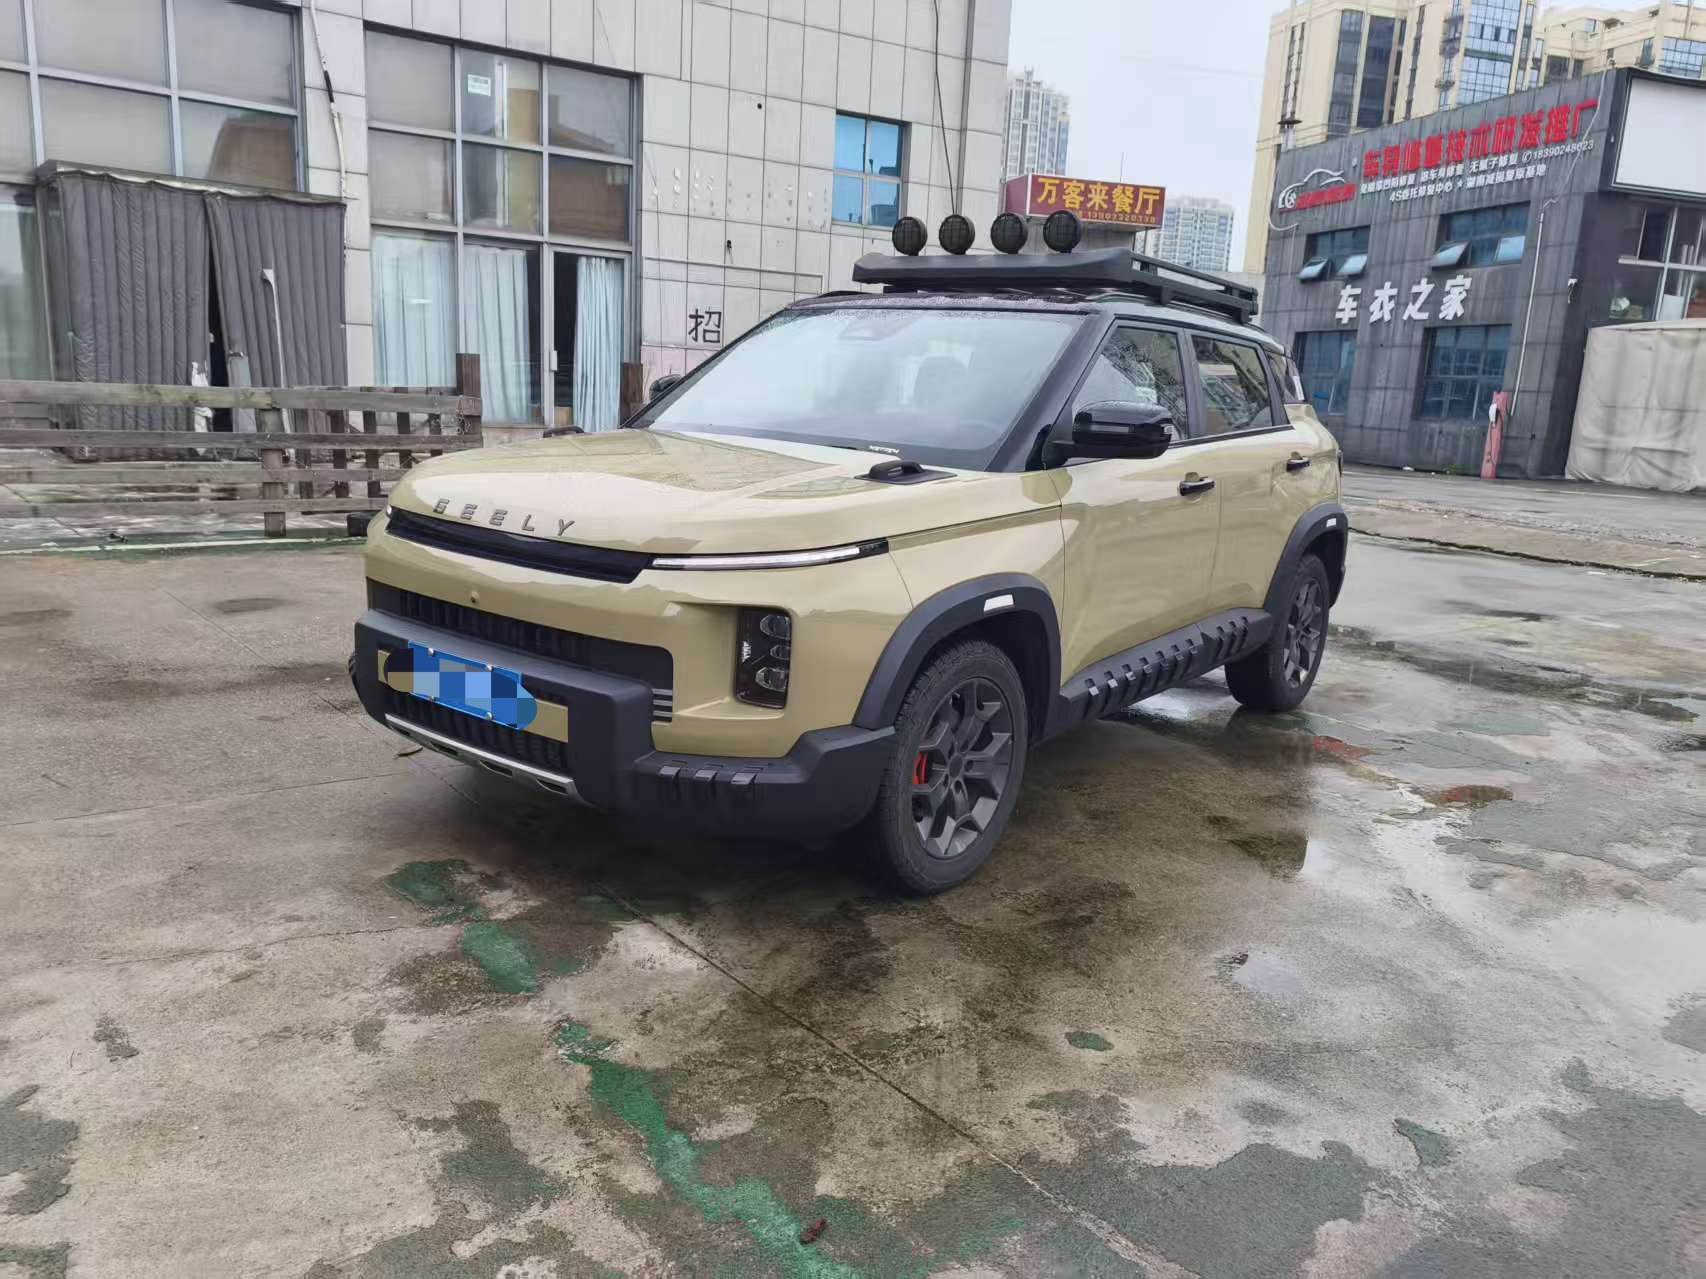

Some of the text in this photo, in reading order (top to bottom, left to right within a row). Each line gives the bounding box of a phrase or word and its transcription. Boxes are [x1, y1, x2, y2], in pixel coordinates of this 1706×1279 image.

[1037, 177, 1161, 215] 万客来餐厅
[1335, 274, 1472, 324] 车衣之家
[688, 307, 722, 343] 招
[433, 498, 575, 536] GEELY
